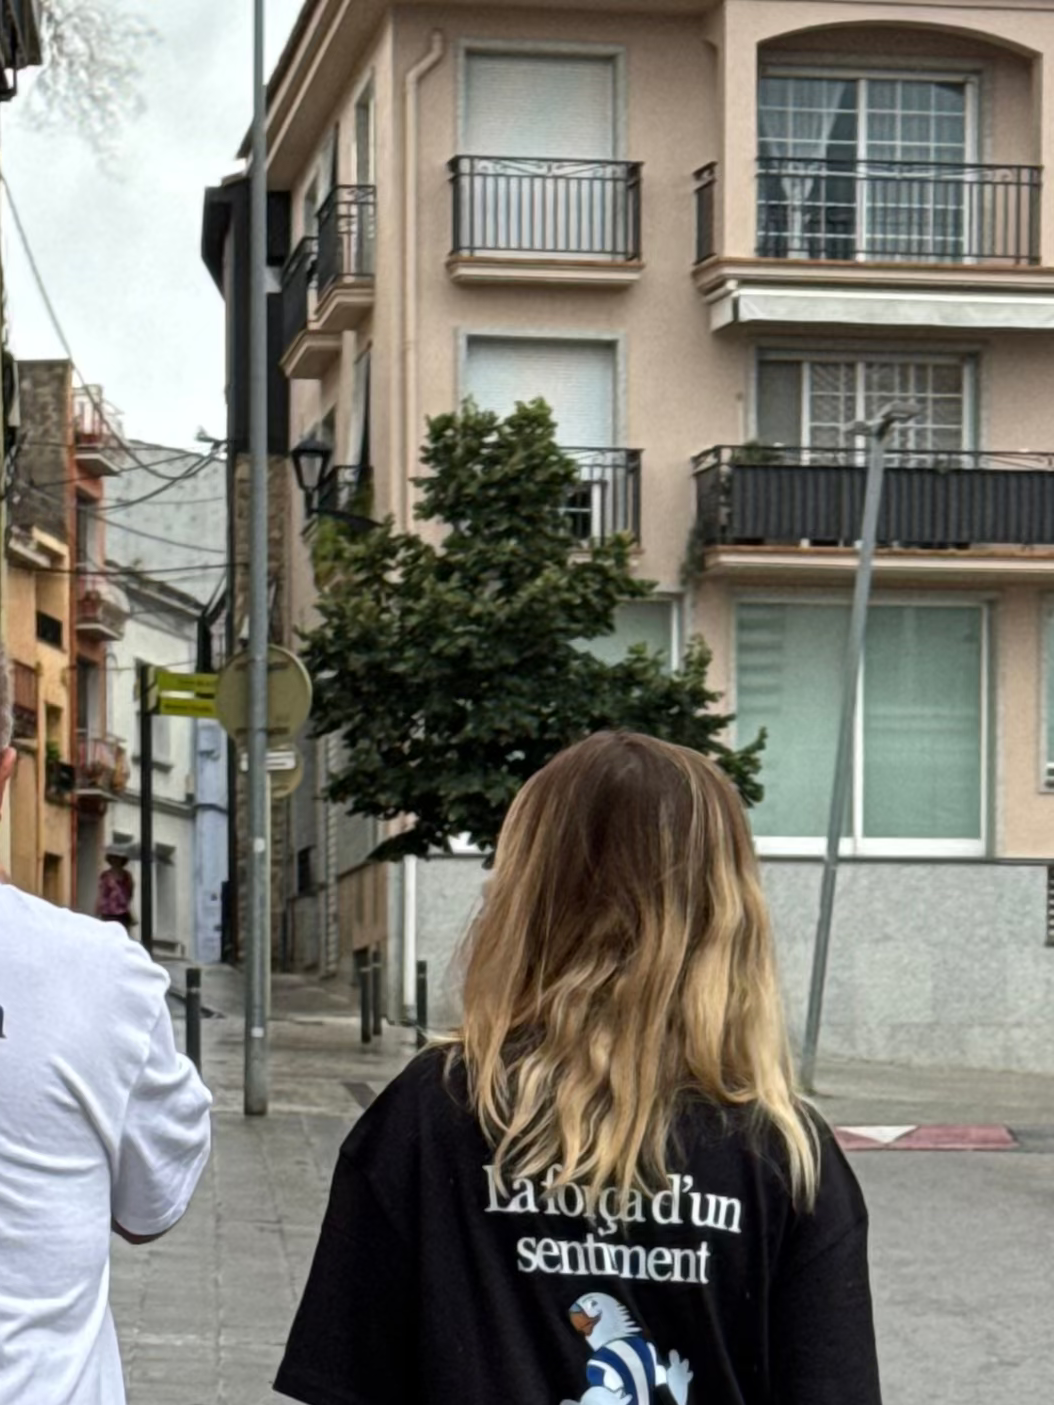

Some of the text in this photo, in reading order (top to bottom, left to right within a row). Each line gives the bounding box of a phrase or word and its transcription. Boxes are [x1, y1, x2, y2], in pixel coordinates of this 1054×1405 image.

[483, 1164, 539, 1213] La
[651, 1174, 742, 1233] d'un
[517, 1233, 711, 1284] sentiment
